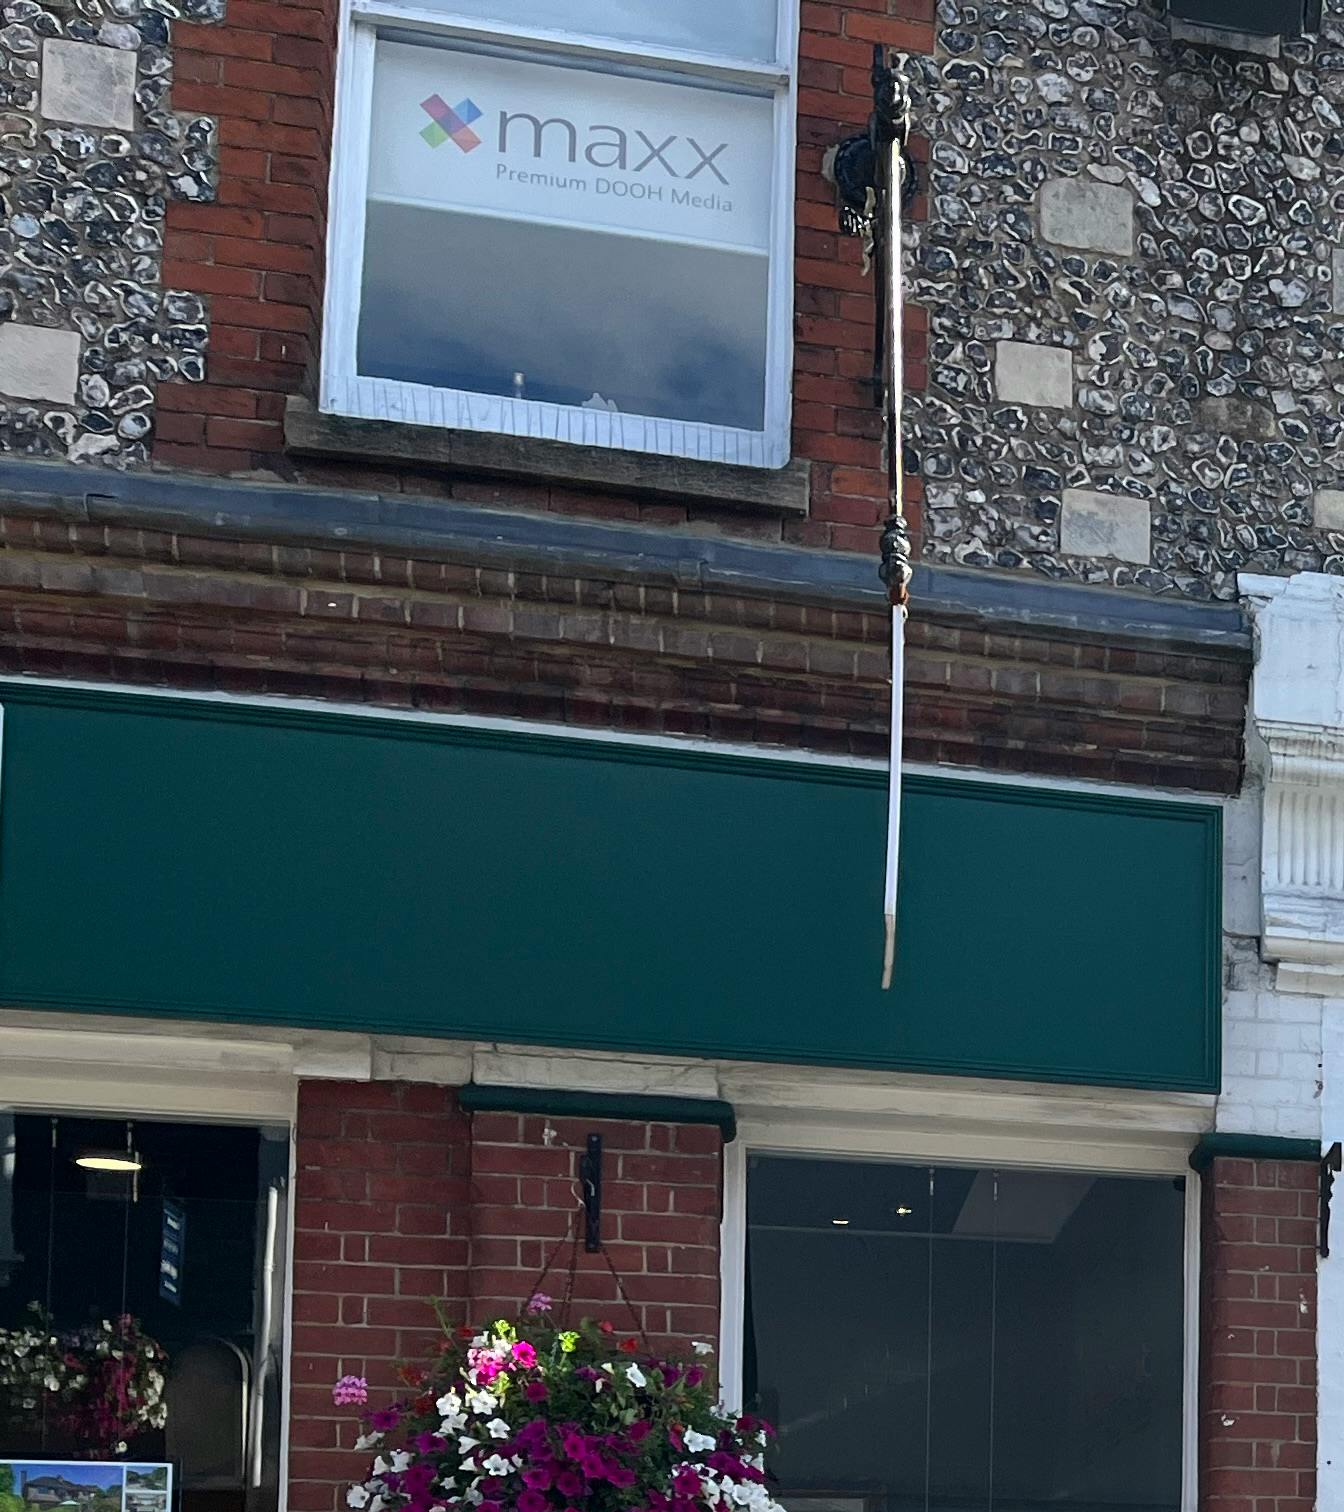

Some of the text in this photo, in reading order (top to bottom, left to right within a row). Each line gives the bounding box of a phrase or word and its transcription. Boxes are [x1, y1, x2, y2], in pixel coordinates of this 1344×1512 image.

[498, 110, 730, 186] maxx
[496, 163, 734, 213] Premium DOOH Media
